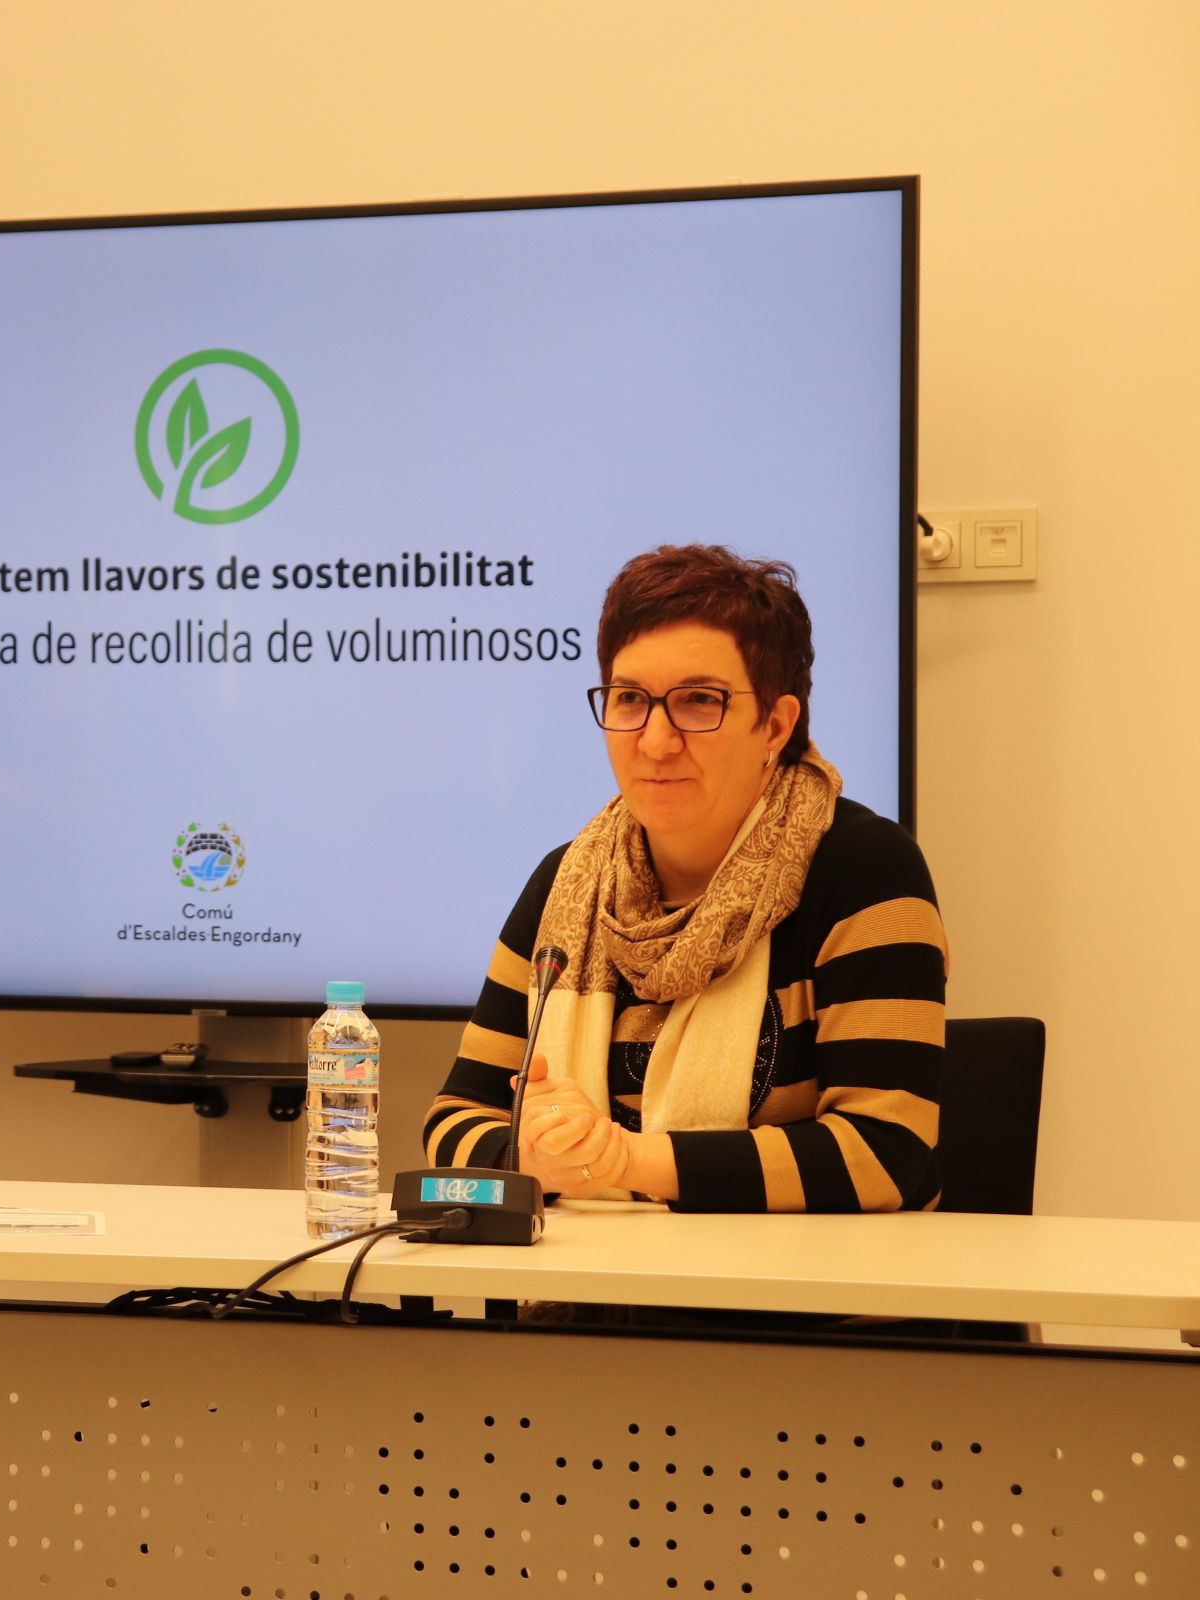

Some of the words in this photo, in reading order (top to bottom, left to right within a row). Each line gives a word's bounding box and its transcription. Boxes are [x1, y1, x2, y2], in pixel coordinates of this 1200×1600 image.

[82, 557, 206, 592] llavors
[216, 553, 261, 591] de
[271, 550, 535, 590] sostenibilitat
[32, 620, 77, 665] de
[90, 618, 252, 665] recollida
[267, 618, 314, 664] de
[326, 616, 583, 663] voluminosos
[181, 902, 234, 920] Comú
